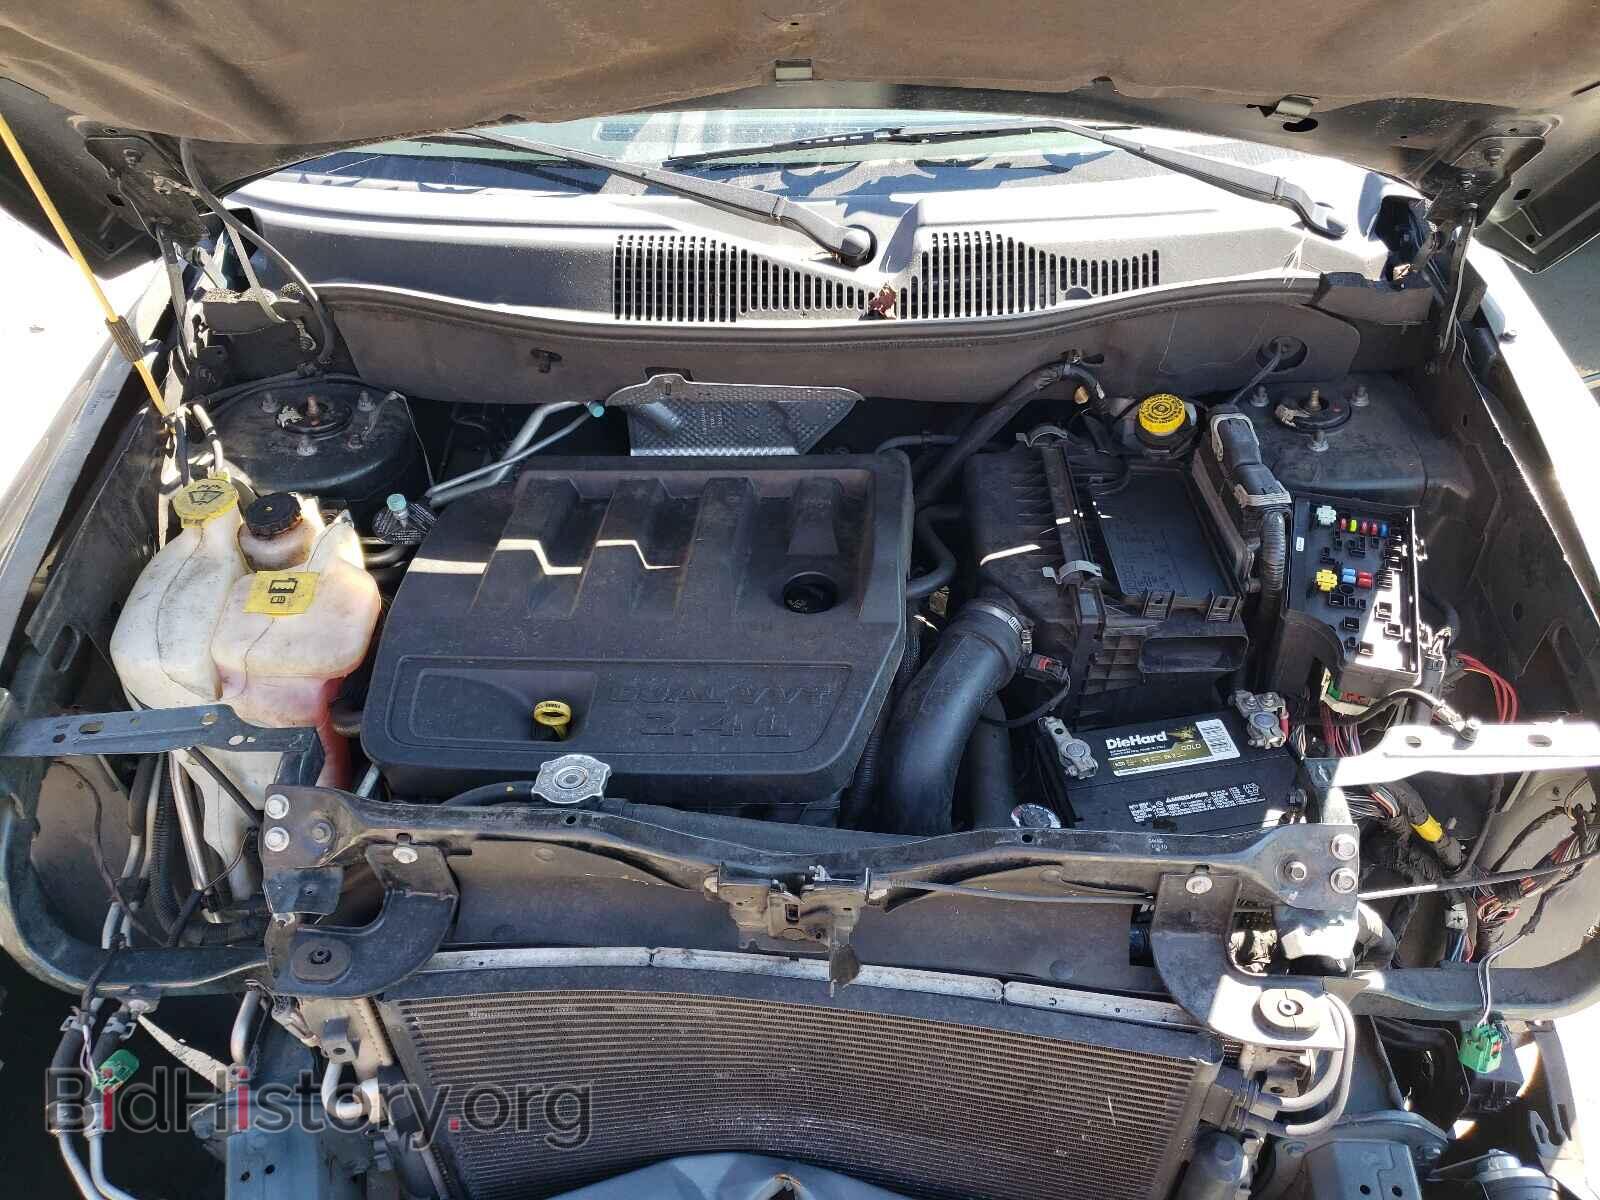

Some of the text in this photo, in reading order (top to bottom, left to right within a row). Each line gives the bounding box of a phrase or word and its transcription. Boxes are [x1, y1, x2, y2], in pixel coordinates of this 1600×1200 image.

[608, 685, 834, 706] DUAL VVT
[638, 709, 793, 738] 2.4L
[1105, 731, 1167, 750] DieHard
[1181, 743, 1202, 752] GOLD
